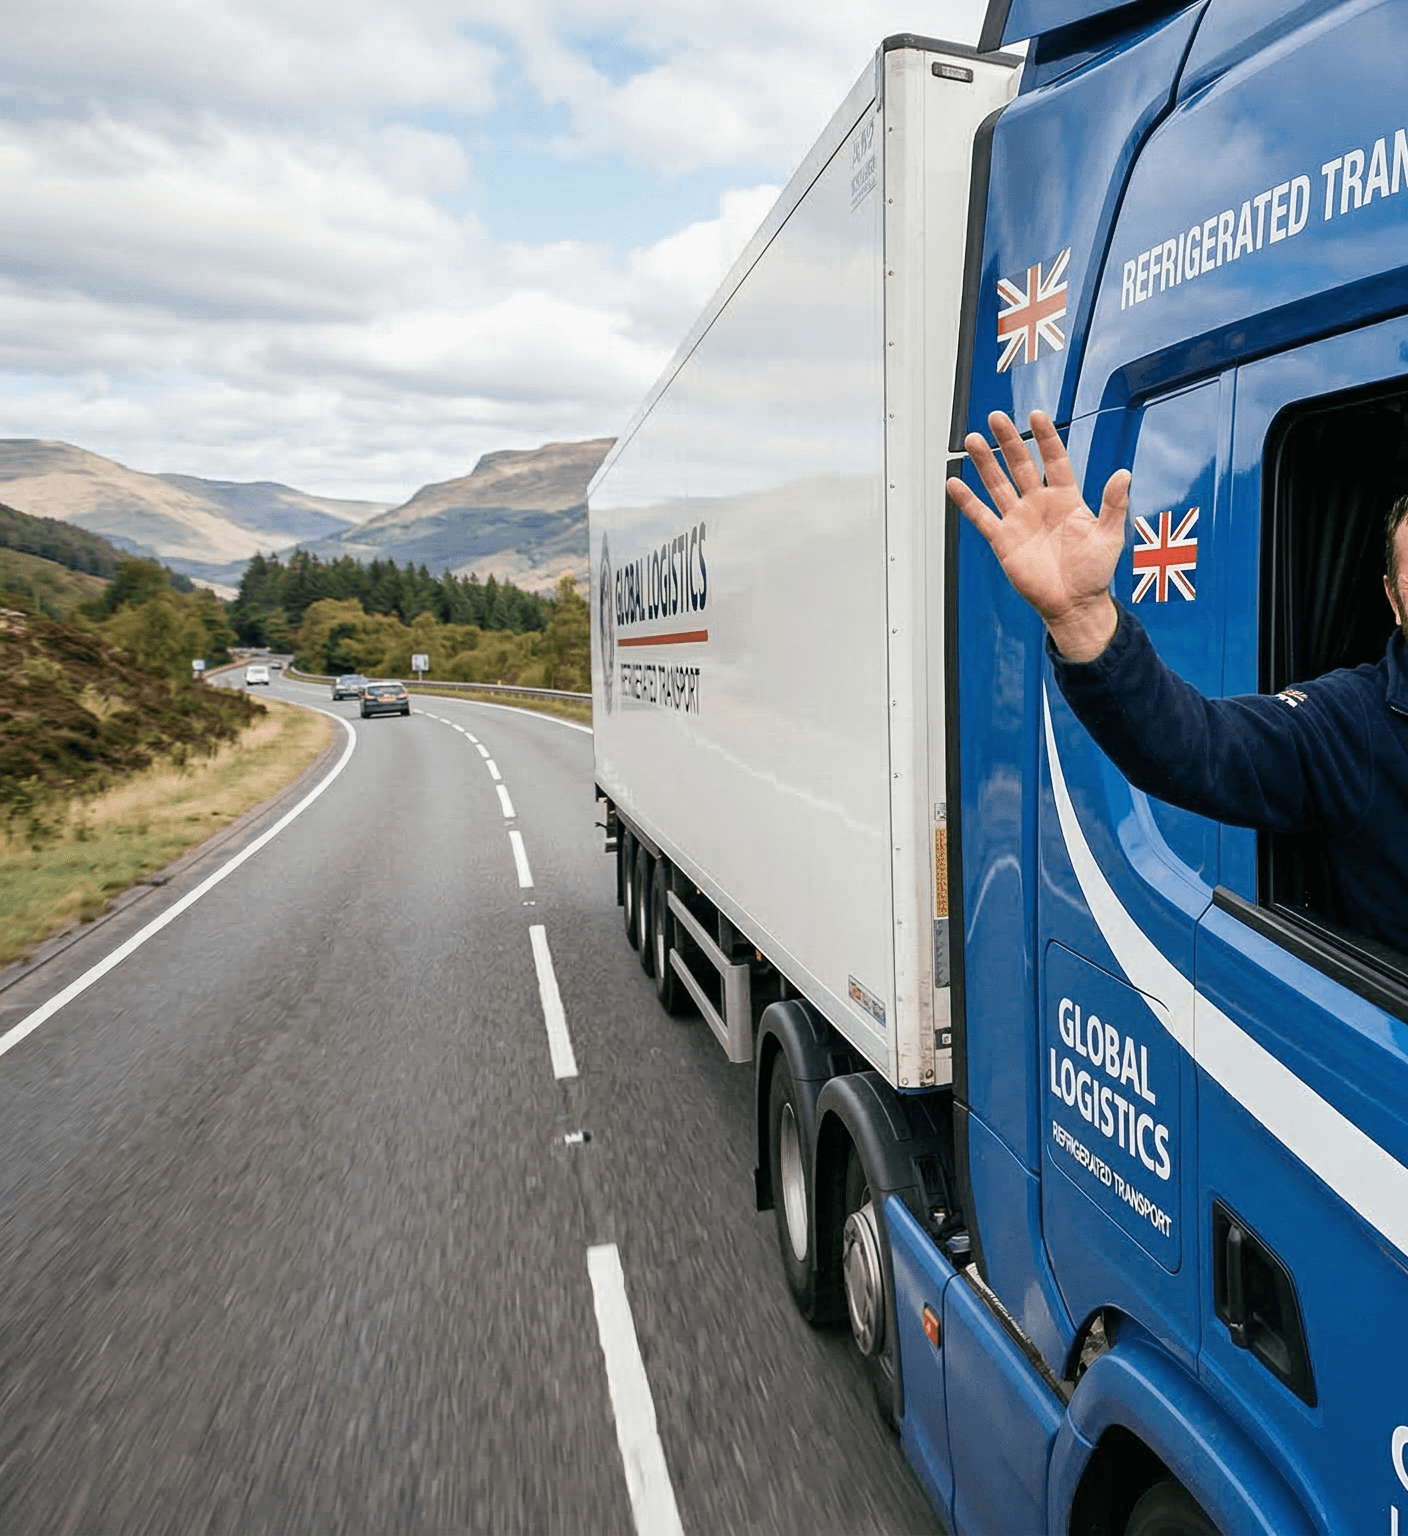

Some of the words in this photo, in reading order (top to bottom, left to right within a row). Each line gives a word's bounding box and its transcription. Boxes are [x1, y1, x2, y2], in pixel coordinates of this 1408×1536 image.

[1120, 175, 1311, 311] REFRIGERATED
[647, 521, 707, 620] LOGISTICS
[1058, 997, 1156, 1106] GLOBAL
[1050, 1047, 1171, 1181] LOGISTICS
[1112, 1171, 1173, 1238] TRANSPORT
